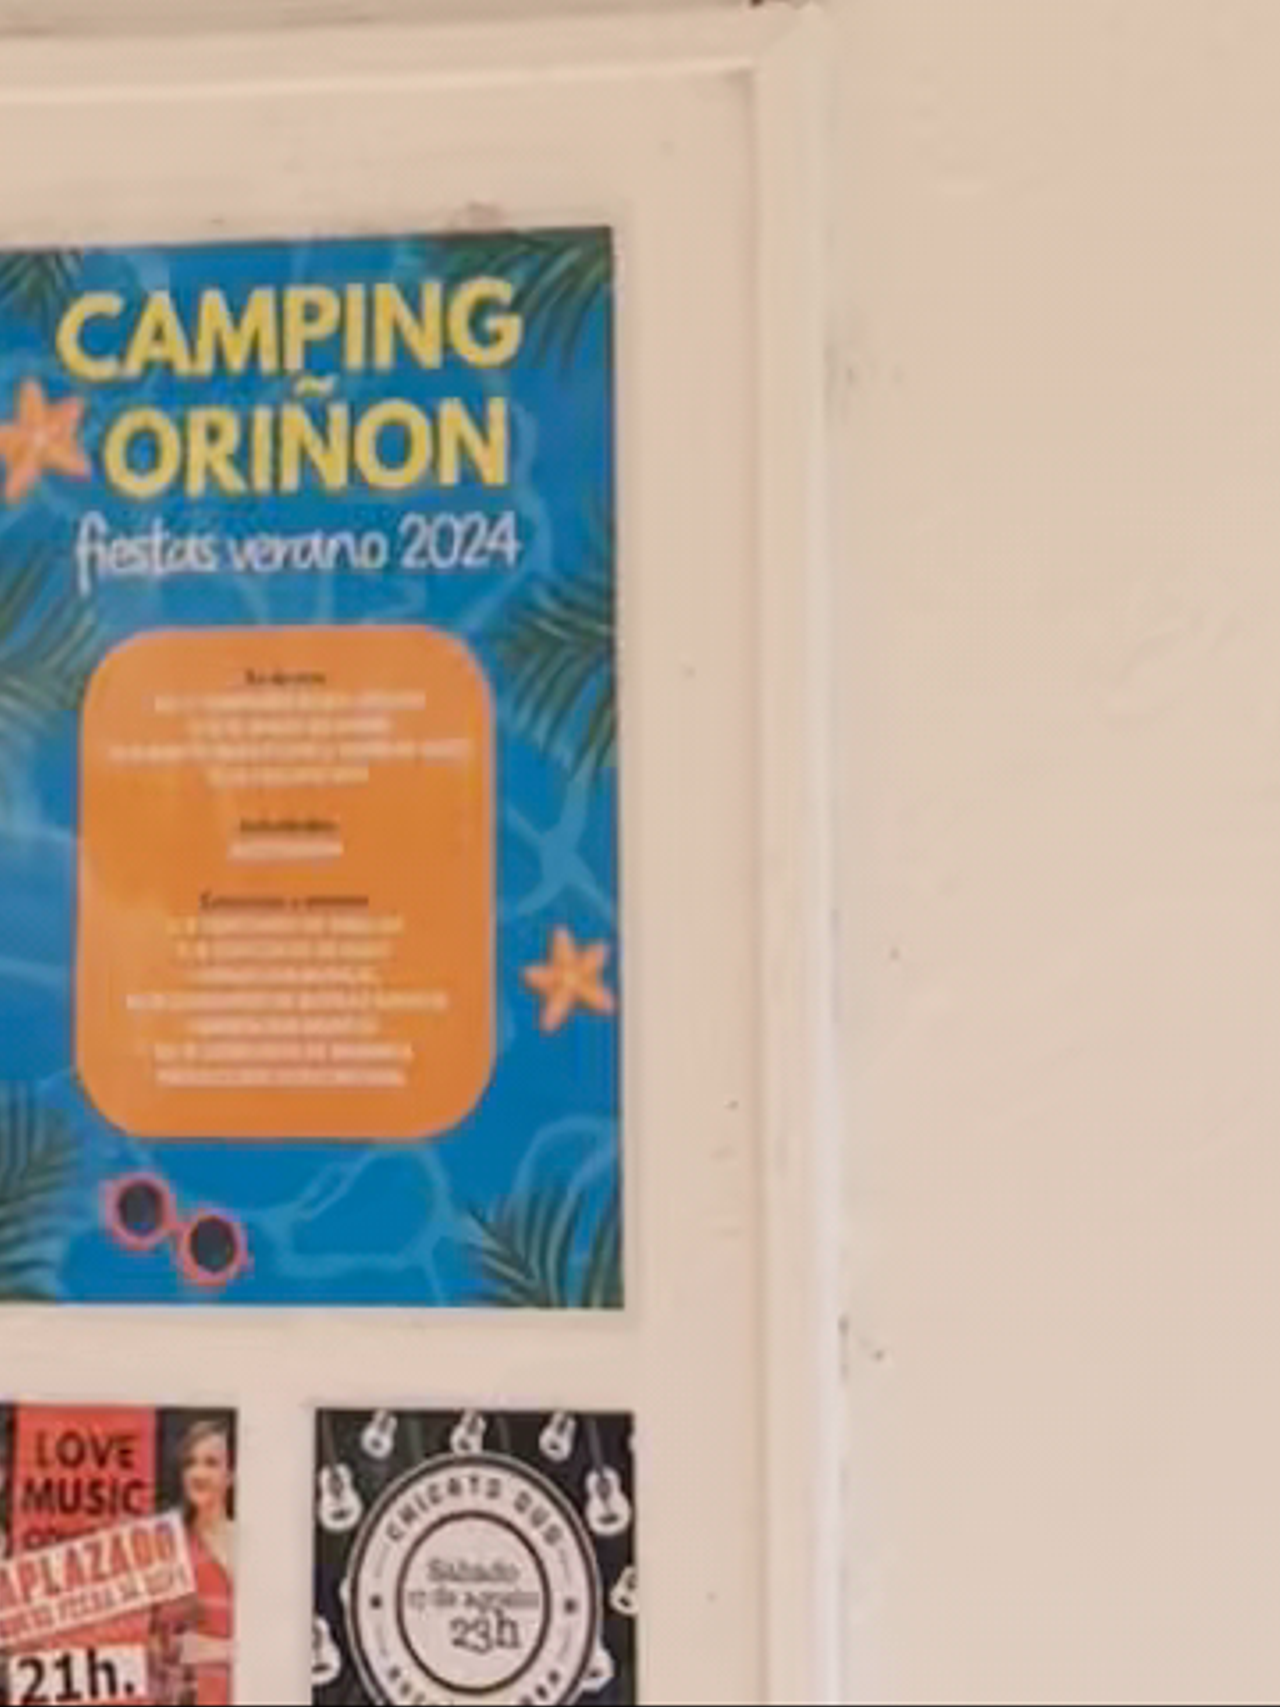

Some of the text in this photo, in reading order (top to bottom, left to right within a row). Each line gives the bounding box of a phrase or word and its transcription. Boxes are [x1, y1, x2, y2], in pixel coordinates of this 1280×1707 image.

[56, 277, 522, 380] CAMPING
[104, 375, 508, 499] ORIÑON
[75, 511, 520, 596] fiestas verano 2024
[36, 1431, 138, 1470] LOVE
[21, 1479, 148, 1517] MUSIC
[450, 1606, 522, 1656] 23h
[19, 1648, 135, 1704] 21h.
